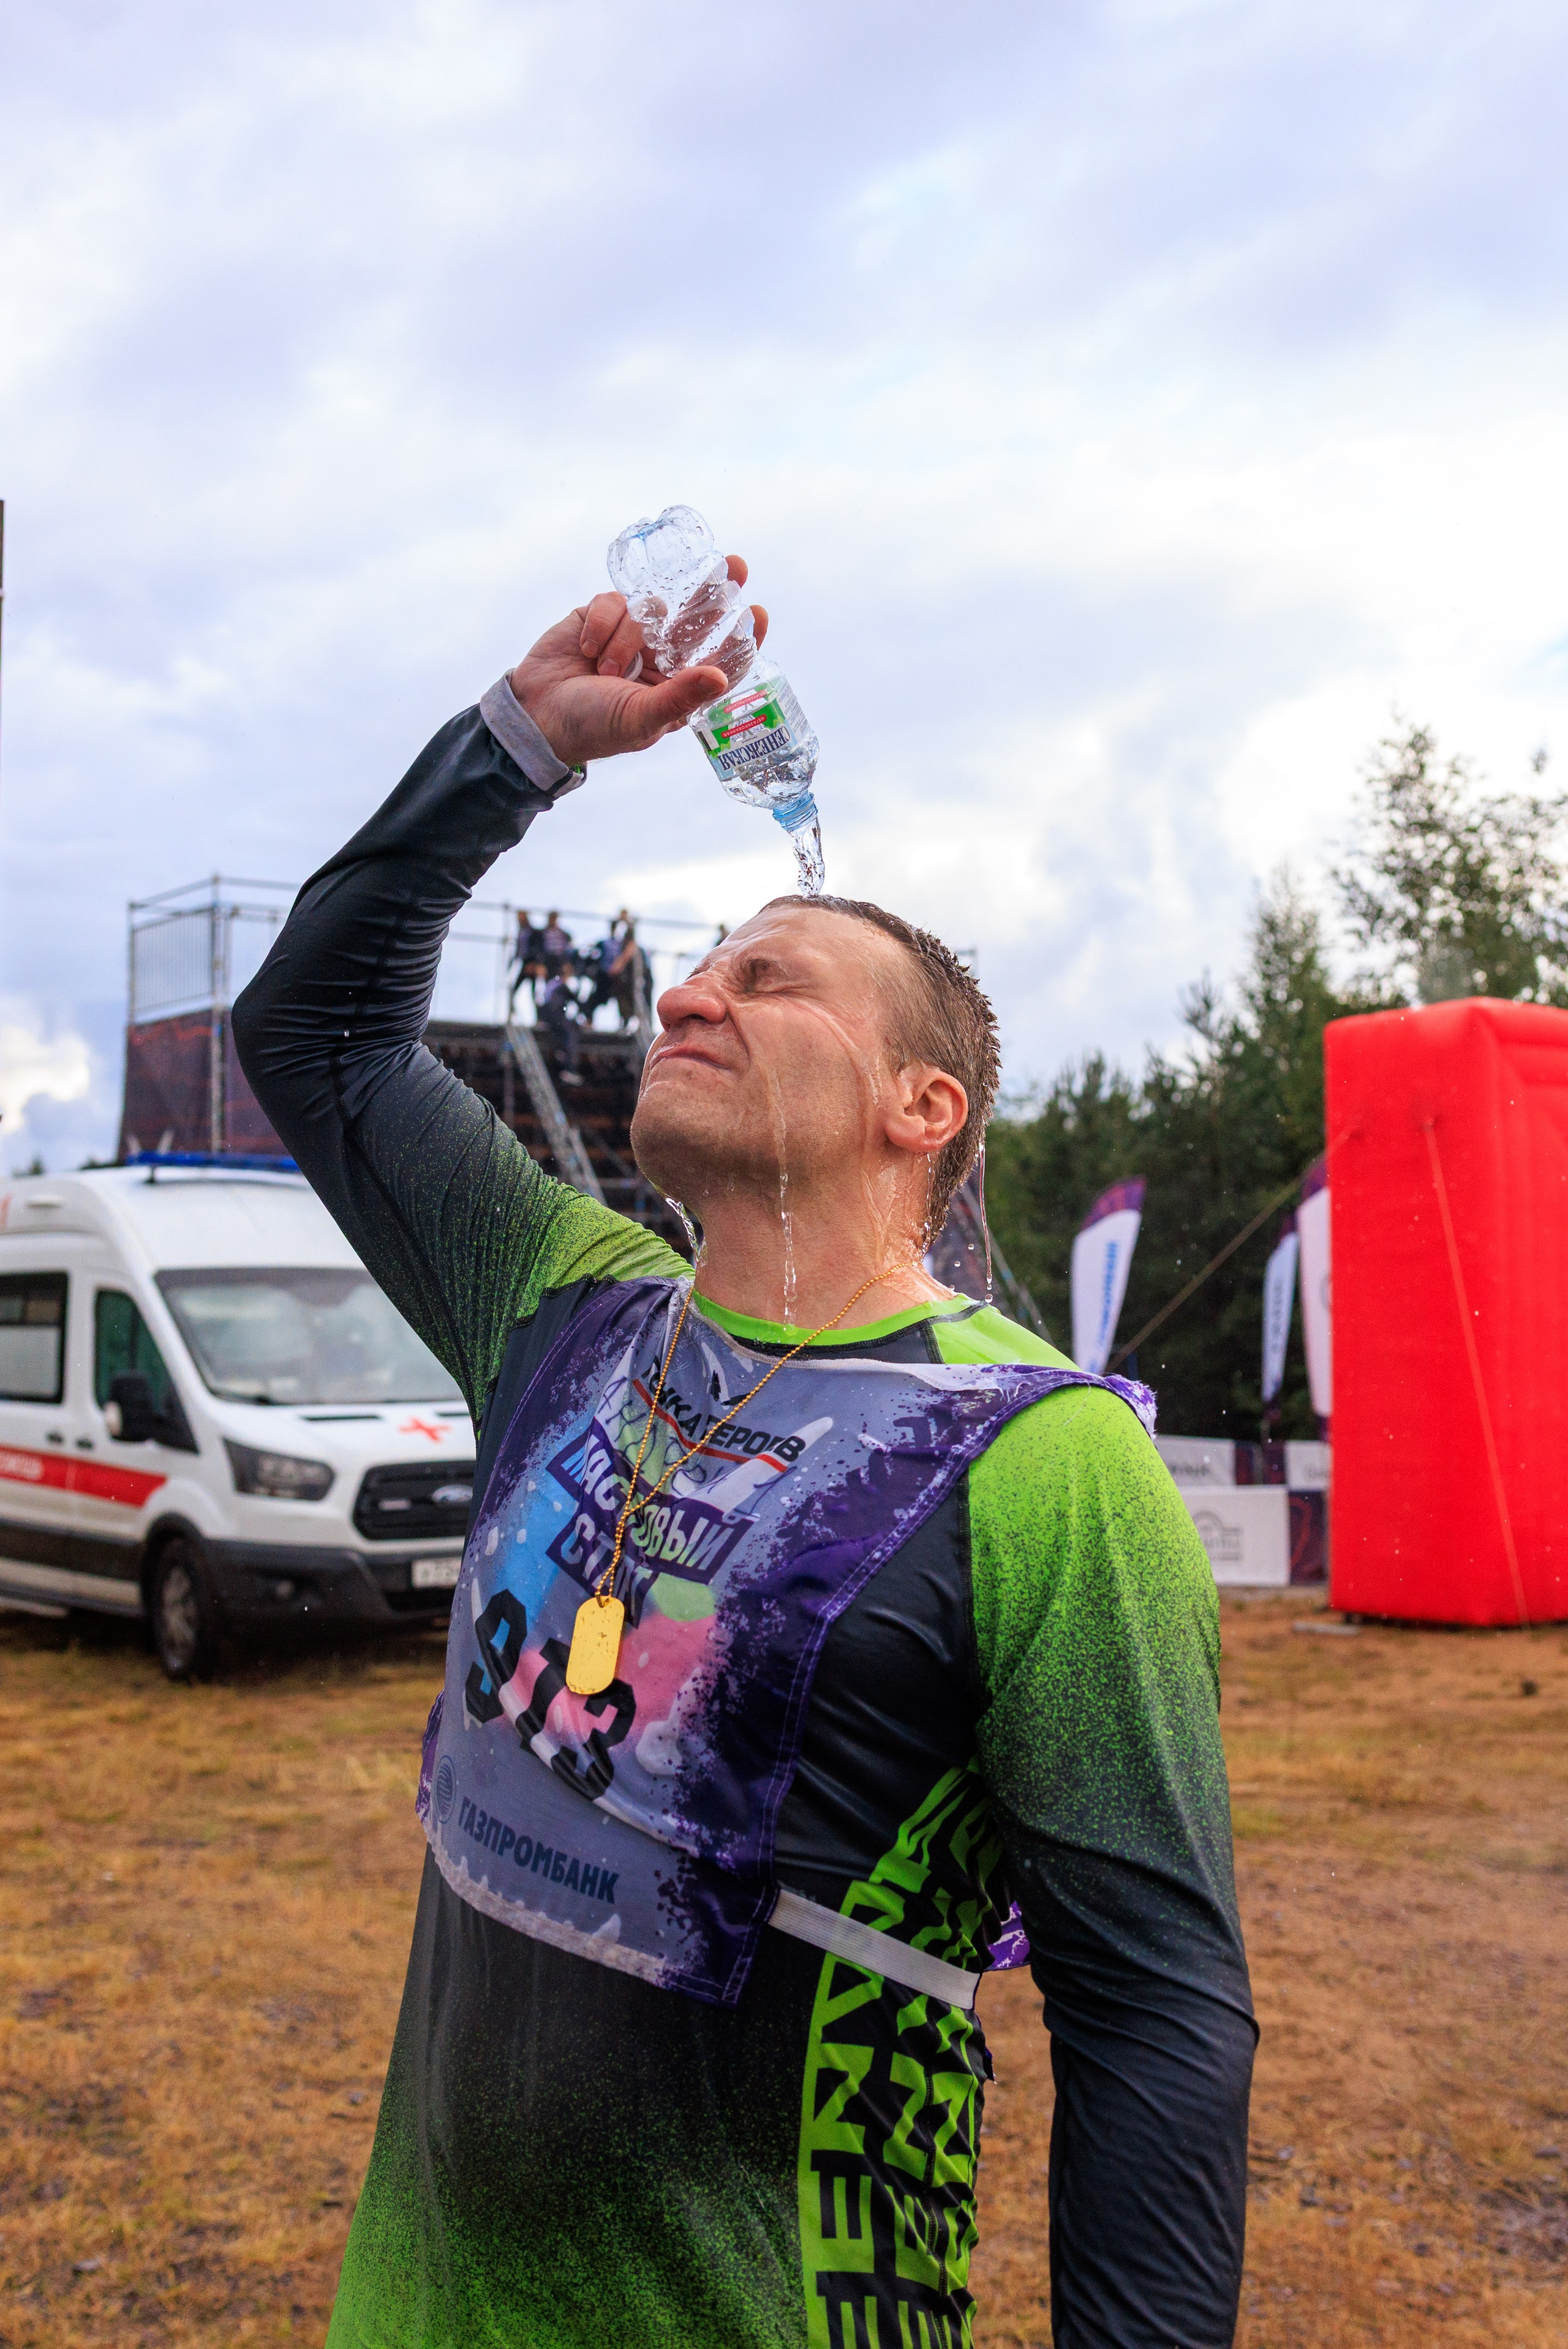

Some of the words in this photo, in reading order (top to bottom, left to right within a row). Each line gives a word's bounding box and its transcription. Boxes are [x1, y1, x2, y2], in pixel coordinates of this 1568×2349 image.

[717, 725, 791, 771] СЕНЕЖСКАЯ
[722, 715, 766, 738] НЕГАЗИРОВАННАЯ
[458, 1796, 620, 1904] ГАЗПРОМБАНК
